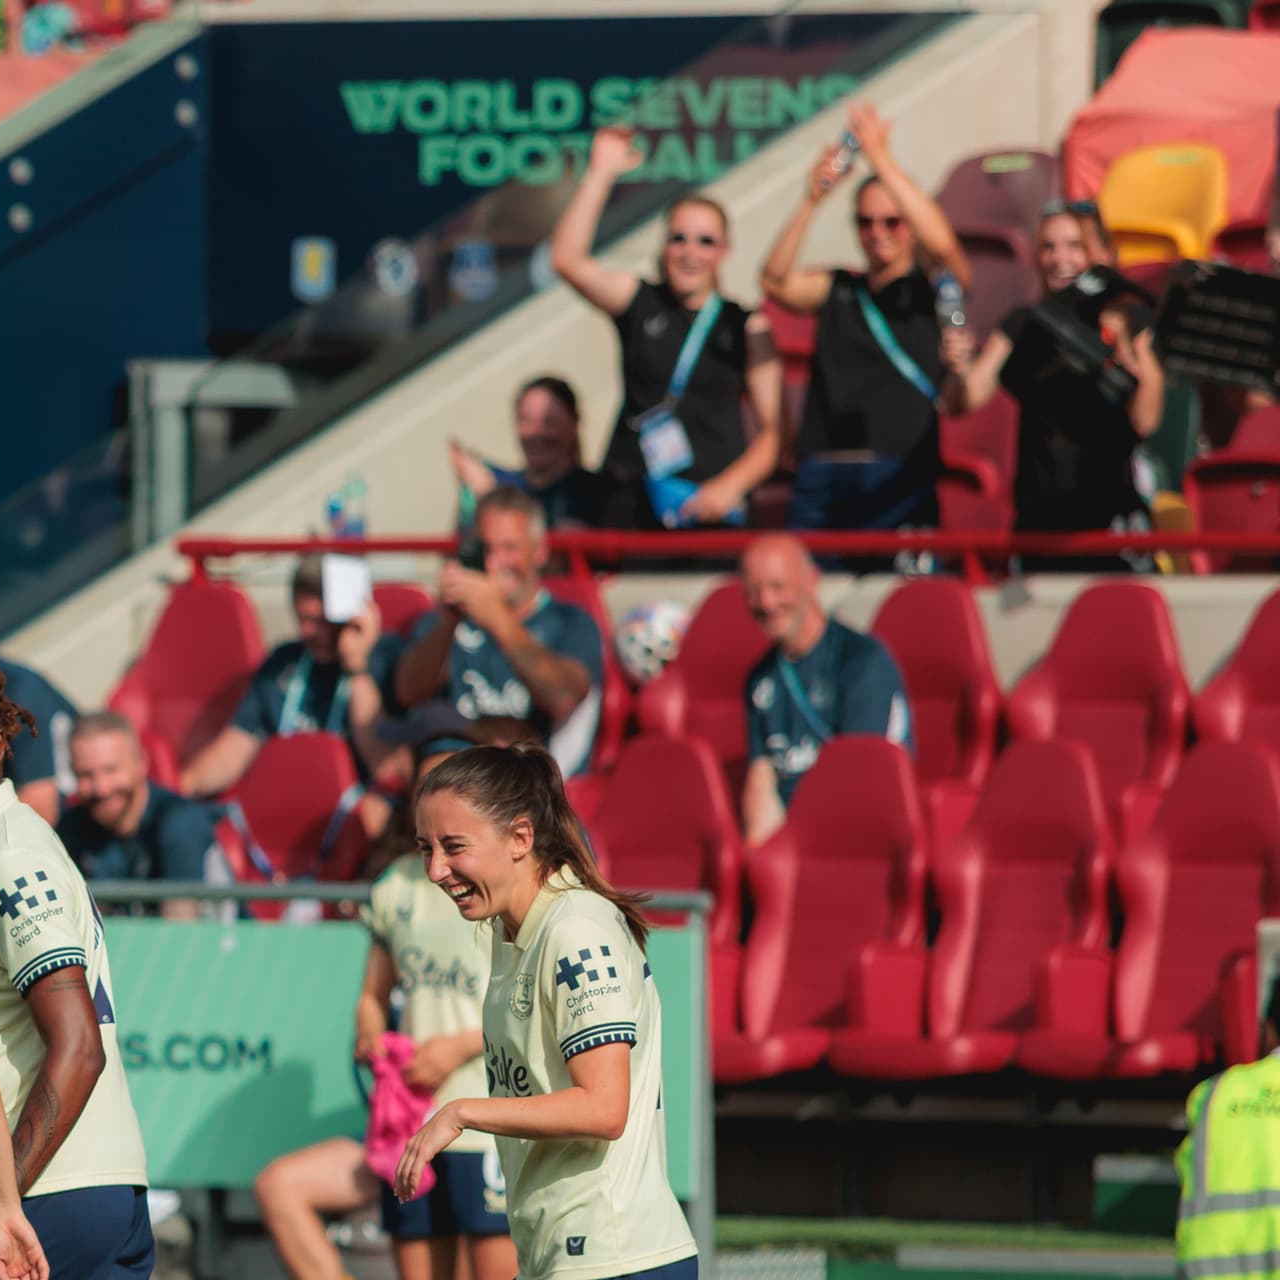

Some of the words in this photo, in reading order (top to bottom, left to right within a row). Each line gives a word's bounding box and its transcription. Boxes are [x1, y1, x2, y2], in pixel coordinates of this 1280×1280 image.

[341, 80, 584, 133] WORLD
[418, 132, 762, 186] FOOTAL
[16, 927, 41, 948] Ward
